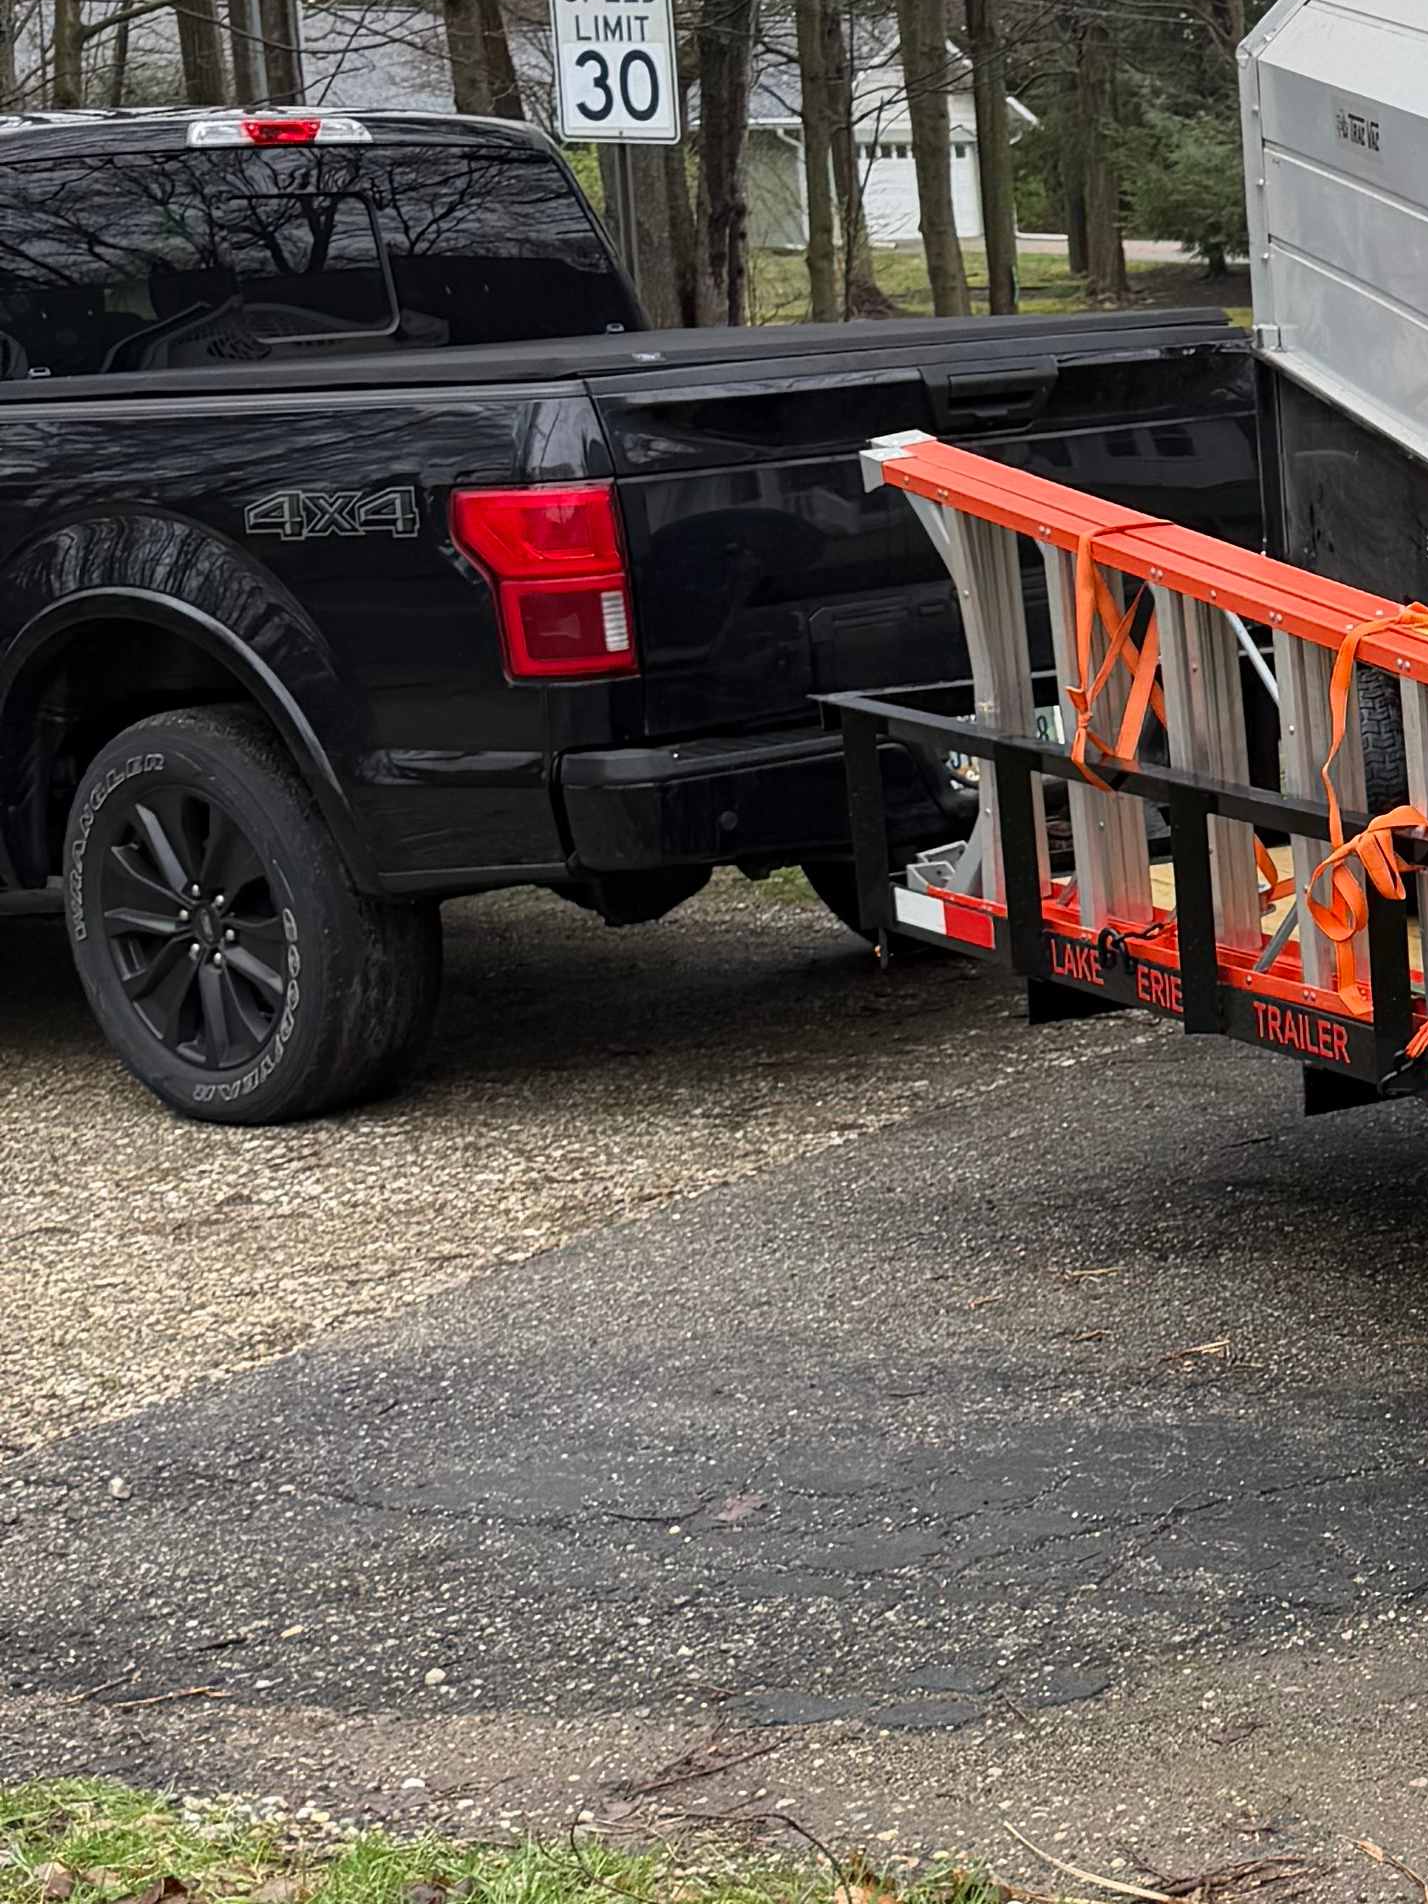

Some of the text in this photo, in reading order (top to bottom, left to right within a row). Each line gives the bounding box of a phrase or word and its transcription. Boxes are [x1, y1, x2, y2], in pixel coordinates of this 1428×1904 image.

[575, 15, 649, 42] LIMIT
[575, 49, 660, 122] 30
[69, 752, 165, 942] WRANGLER
[193, 907, 300, 1102] GOODYEAR
[1051, 939, 1104, 986] LAKE
[1137, 964, 1184, 1014] ERIE
[1253, 1001, 1351, 1064] TRAILER
